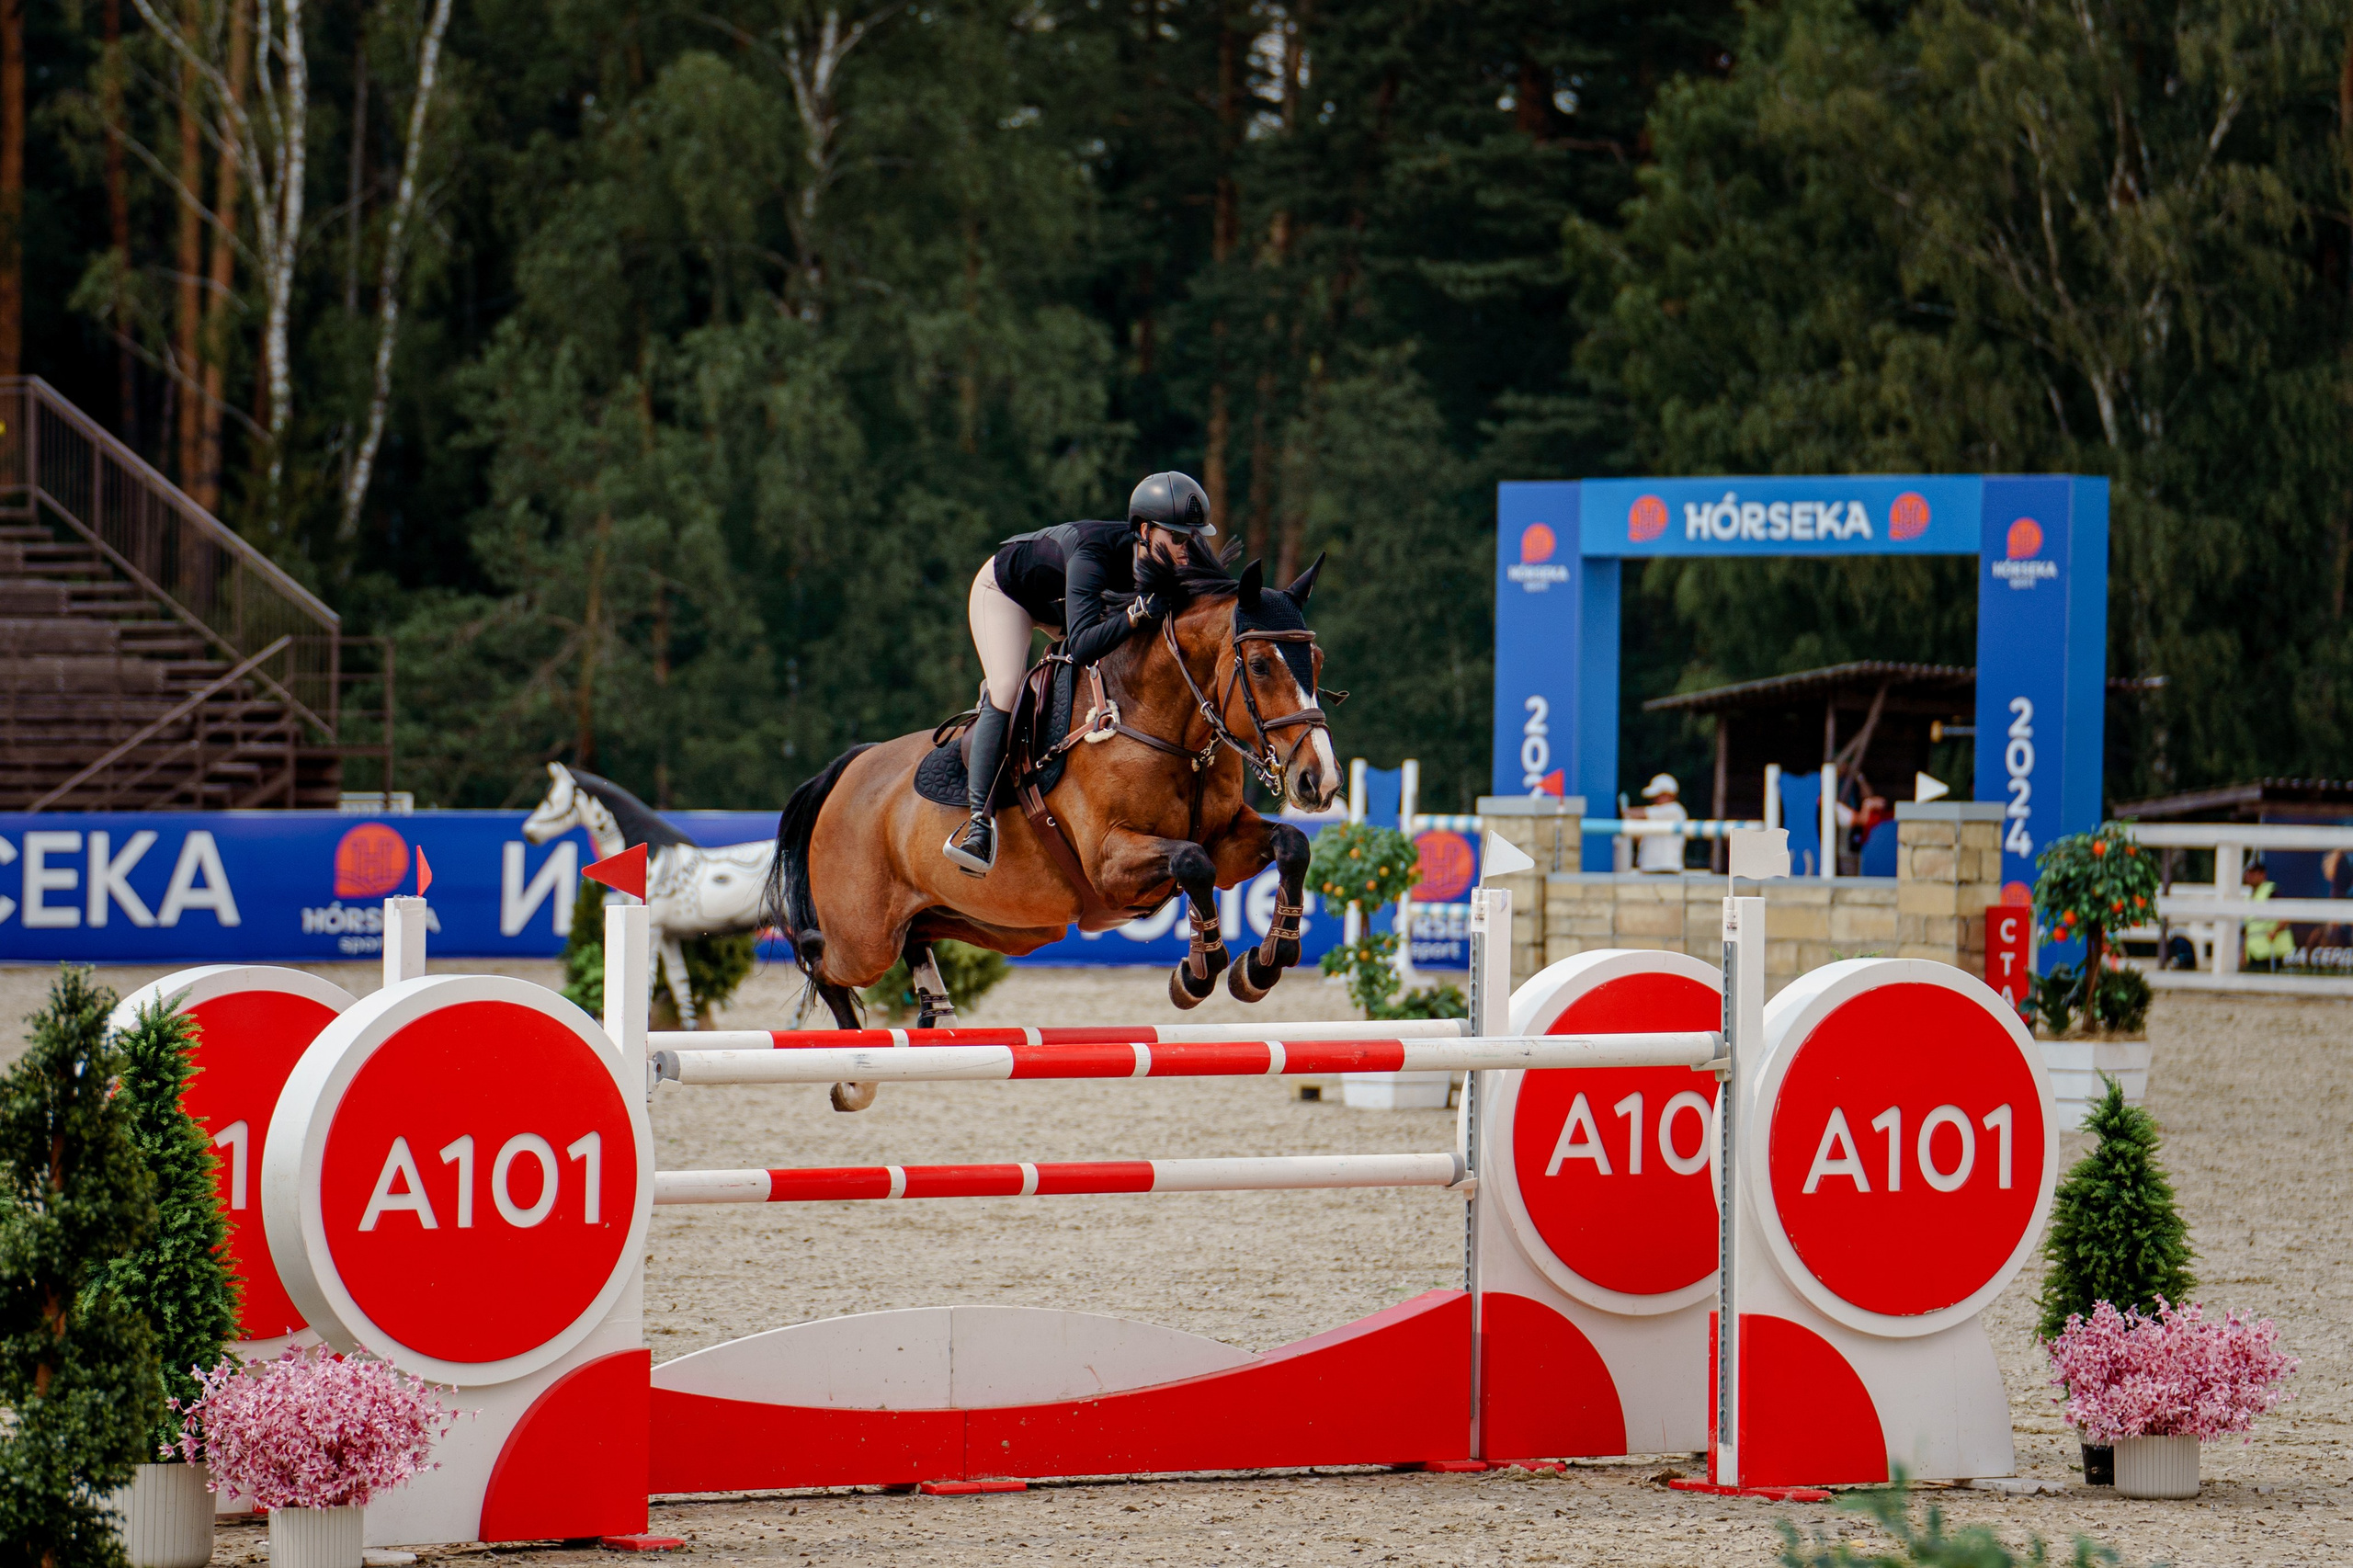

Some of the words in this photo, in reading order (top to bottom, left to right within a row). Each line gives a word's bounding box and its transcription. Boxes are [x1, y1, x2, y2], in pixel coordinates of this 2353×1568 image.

[1684, 491, 1873, 540] HÓRSEKA
[1521, 696, 1549, 800] 20
[2006, 697, 2035, 858] 2024
[0, 831, 241, 927] ЕКА
[301, 901, 441, 935] HÓRSA
[338, 936, 384, 955] spo
[1545, 1090, 1712, 1176] A10
[1802, 1103, 2013, 1193] A101
[358, 1131, 602, 1232] A101
